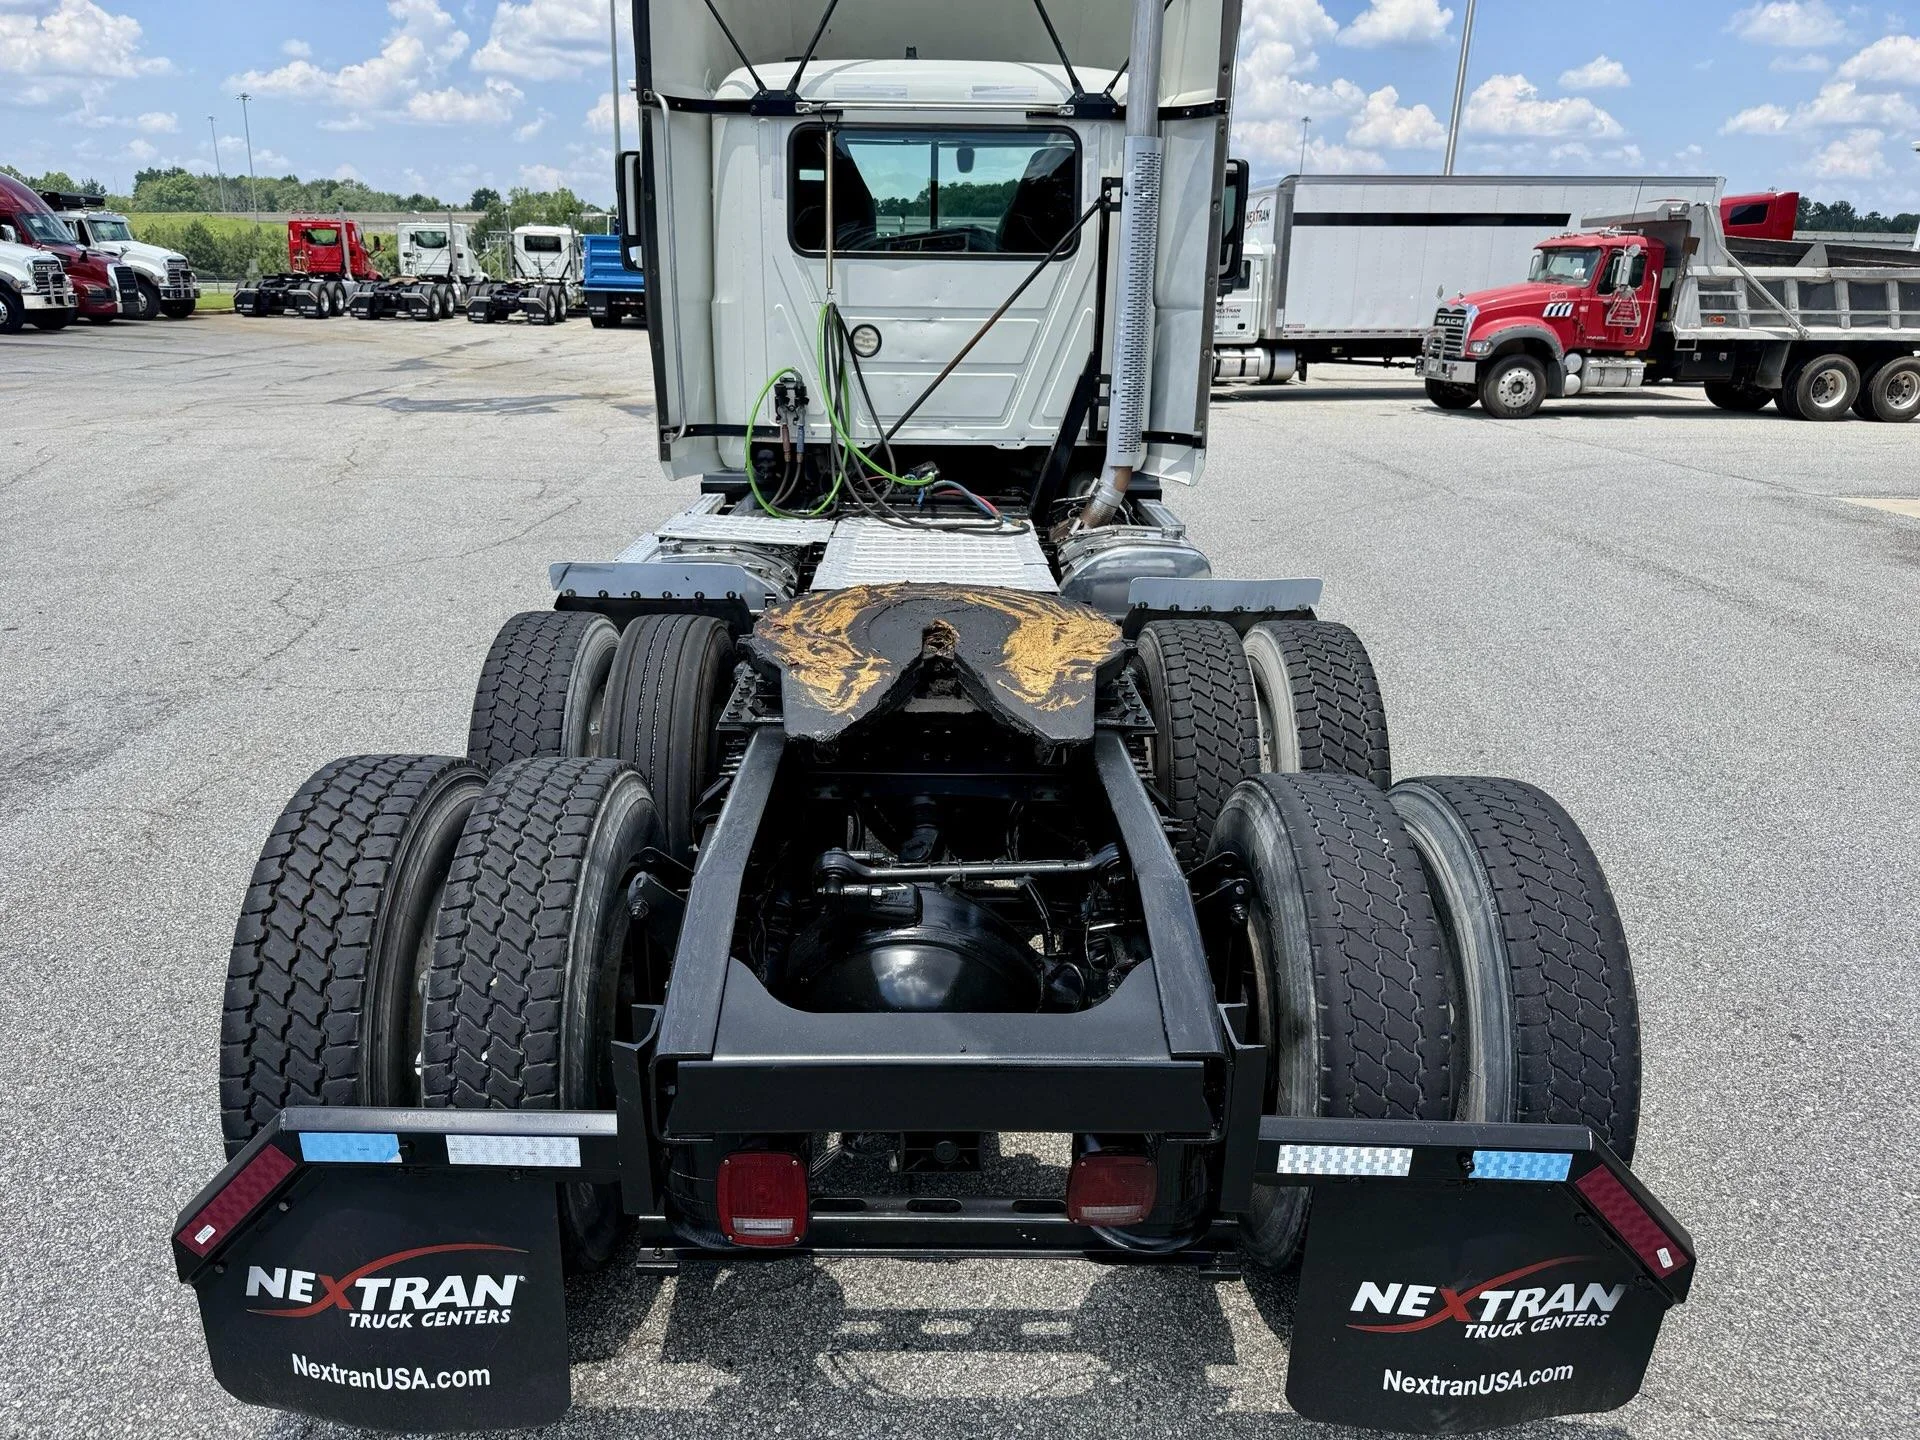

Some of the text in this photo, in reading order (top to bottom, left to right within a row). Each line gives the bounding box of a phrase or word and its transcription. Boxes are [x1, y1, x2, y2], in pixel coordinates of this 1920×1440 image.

[1437, 317, 1463, 325] MACK
[246, 1264, 519, 1311] NEXTRAN
[1349, 1281, 1627, 1322] NEXTRAN
[349, 1308, 512, 1329] TRUCK CENTERS
[1464, 1313, 1611, 1339] TRUCK CENTERS
[291, 1353, 491, 1390] NextranUSA.com
[1382, 1363, 1574, 1397] NextranUSA.com
